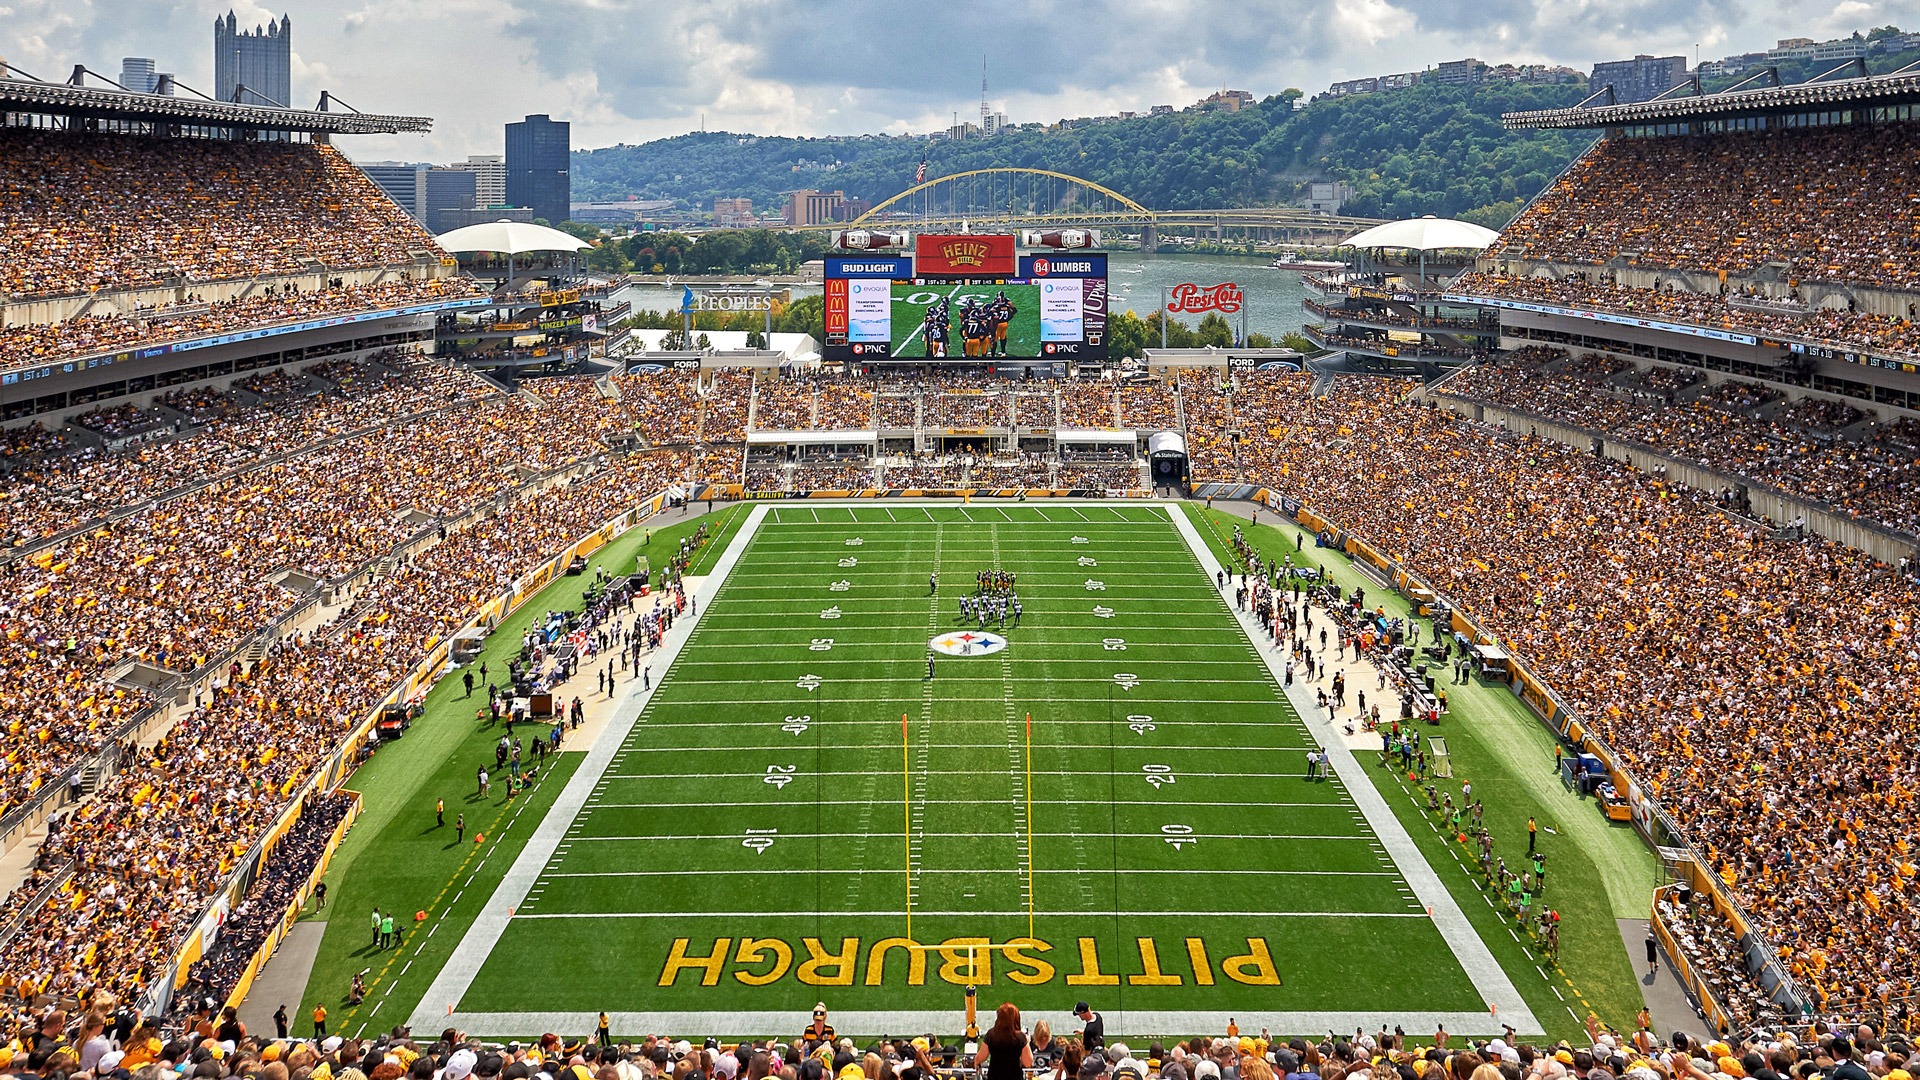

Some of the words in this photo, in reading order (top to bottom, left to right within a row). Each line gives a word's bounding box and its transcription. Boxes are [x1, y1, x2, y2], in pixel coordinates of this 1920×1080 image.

[943, 243, 988, 258] HEINZ
[842, 264, 865, 273] BUD
[865, 264, 895, 273] LIGHT
[1035, 262, 1049, 273] 84
[1051, 262, 1092, 273] LUMBER
[698, 294, 772, 311] PEOPLES
[1083, 279, 1106, 312] UPMC
[539, 321, 565, 330] YINZER
[968, 322, 979, 334] 77
[864, 344, 886, 354] PNC
[1056, 344, 1079, 353] PNC
[1809, 347, 1820, 357] 1ST
[1825, 349, 1833, 359] 10
[1844, 353, 1854, 363] 40
[88, 358, 99, 368] 1ST
[1870, 357, 1881, 367] 1ST
[23, 370, 35, 381] 1ST
[41, 367, 50, 378] 10
[63, 363, 73, 373] 40
[711, 486, 727, 498] 32
[809, 638, 835, 651] 50
[1102, 638, 1127, 651] 50
[781, 715, 811, 732] 30
[1126, 714, 1156, 731] 30
[763, 764, 797, 784] 20
[1142, 764, 1176, 784] 20
[742, 827, 778, 848] 10
[1161, 824, 1198, 845] 10
[656, 936, 1284, 987] PITTSBURGH
